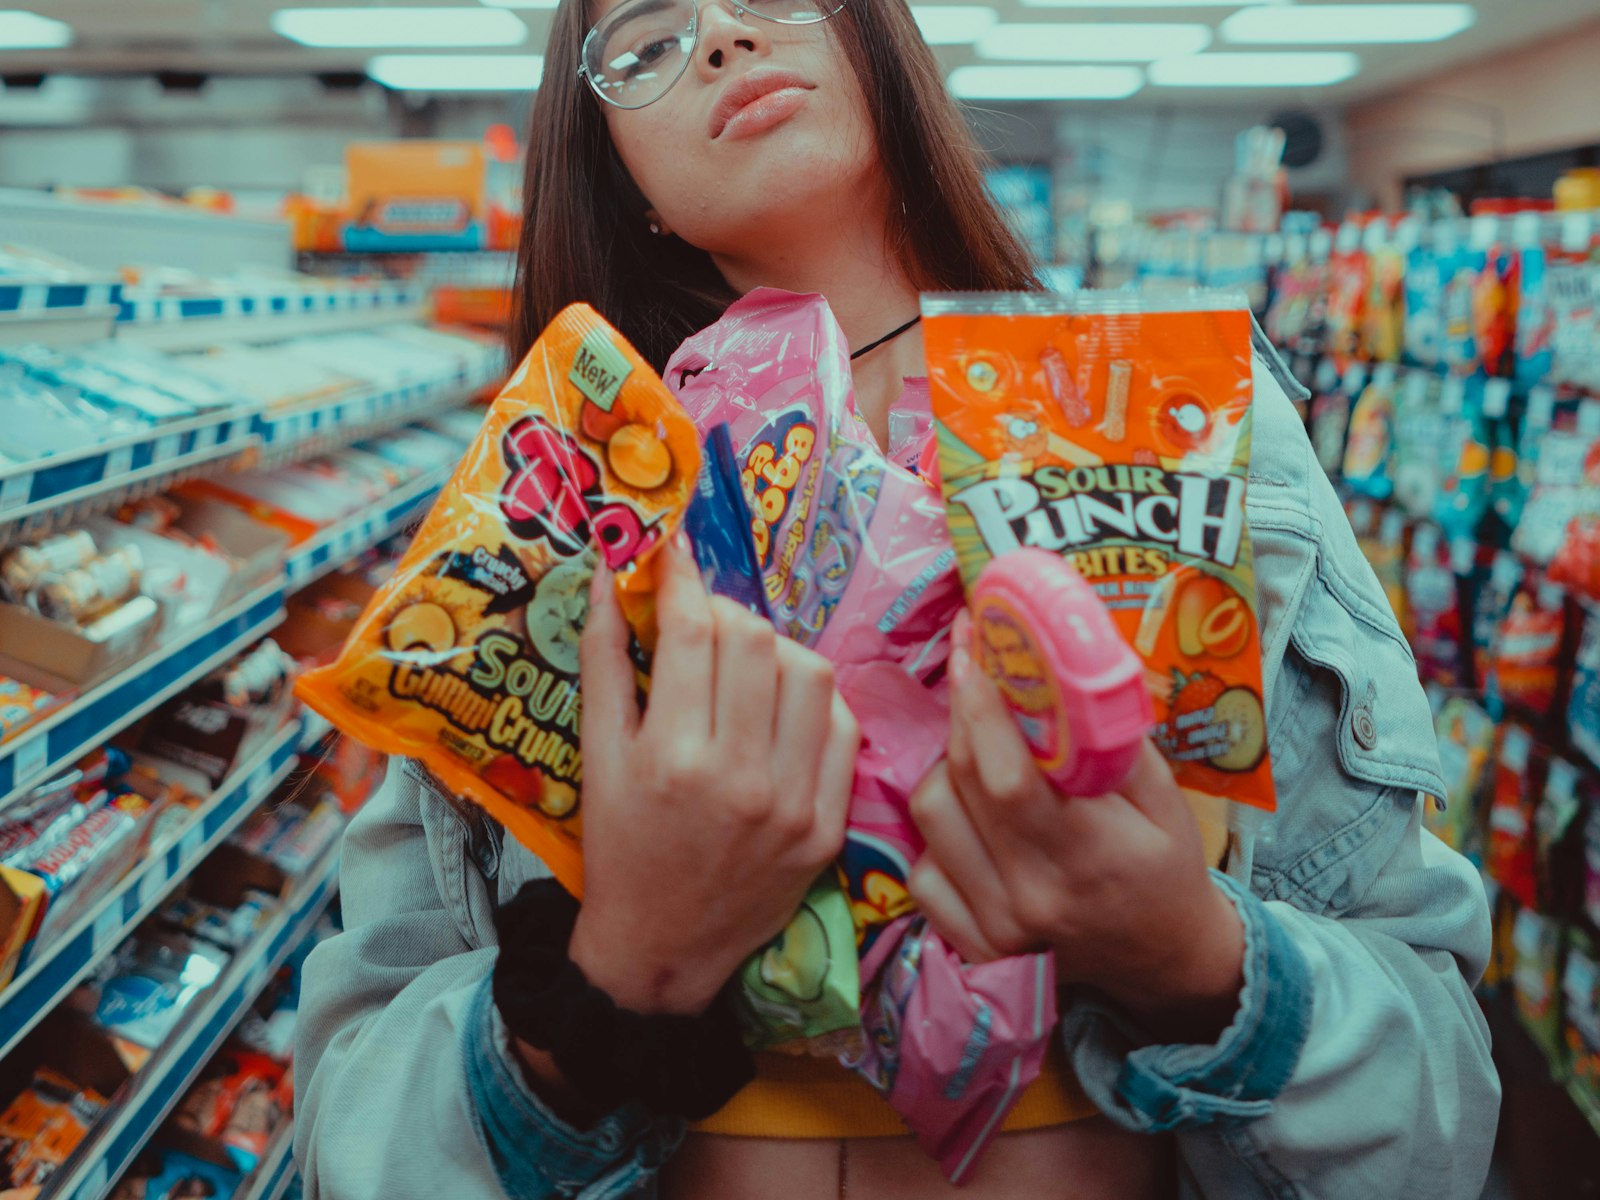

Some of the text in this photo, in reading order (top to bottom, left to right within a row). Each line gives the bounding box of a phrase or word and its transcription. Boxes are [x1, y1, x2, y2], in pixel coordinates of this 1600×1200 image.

[1033, 464, 1171, 499] SOUR
[473, 546, 527, 591] Crunchy
[1070, 548, 1169, 577] BITES
[876, 610, 898, 633] NET
[891, 596, 911, 615] WT
[471, 633, 582, 737] SOUR
